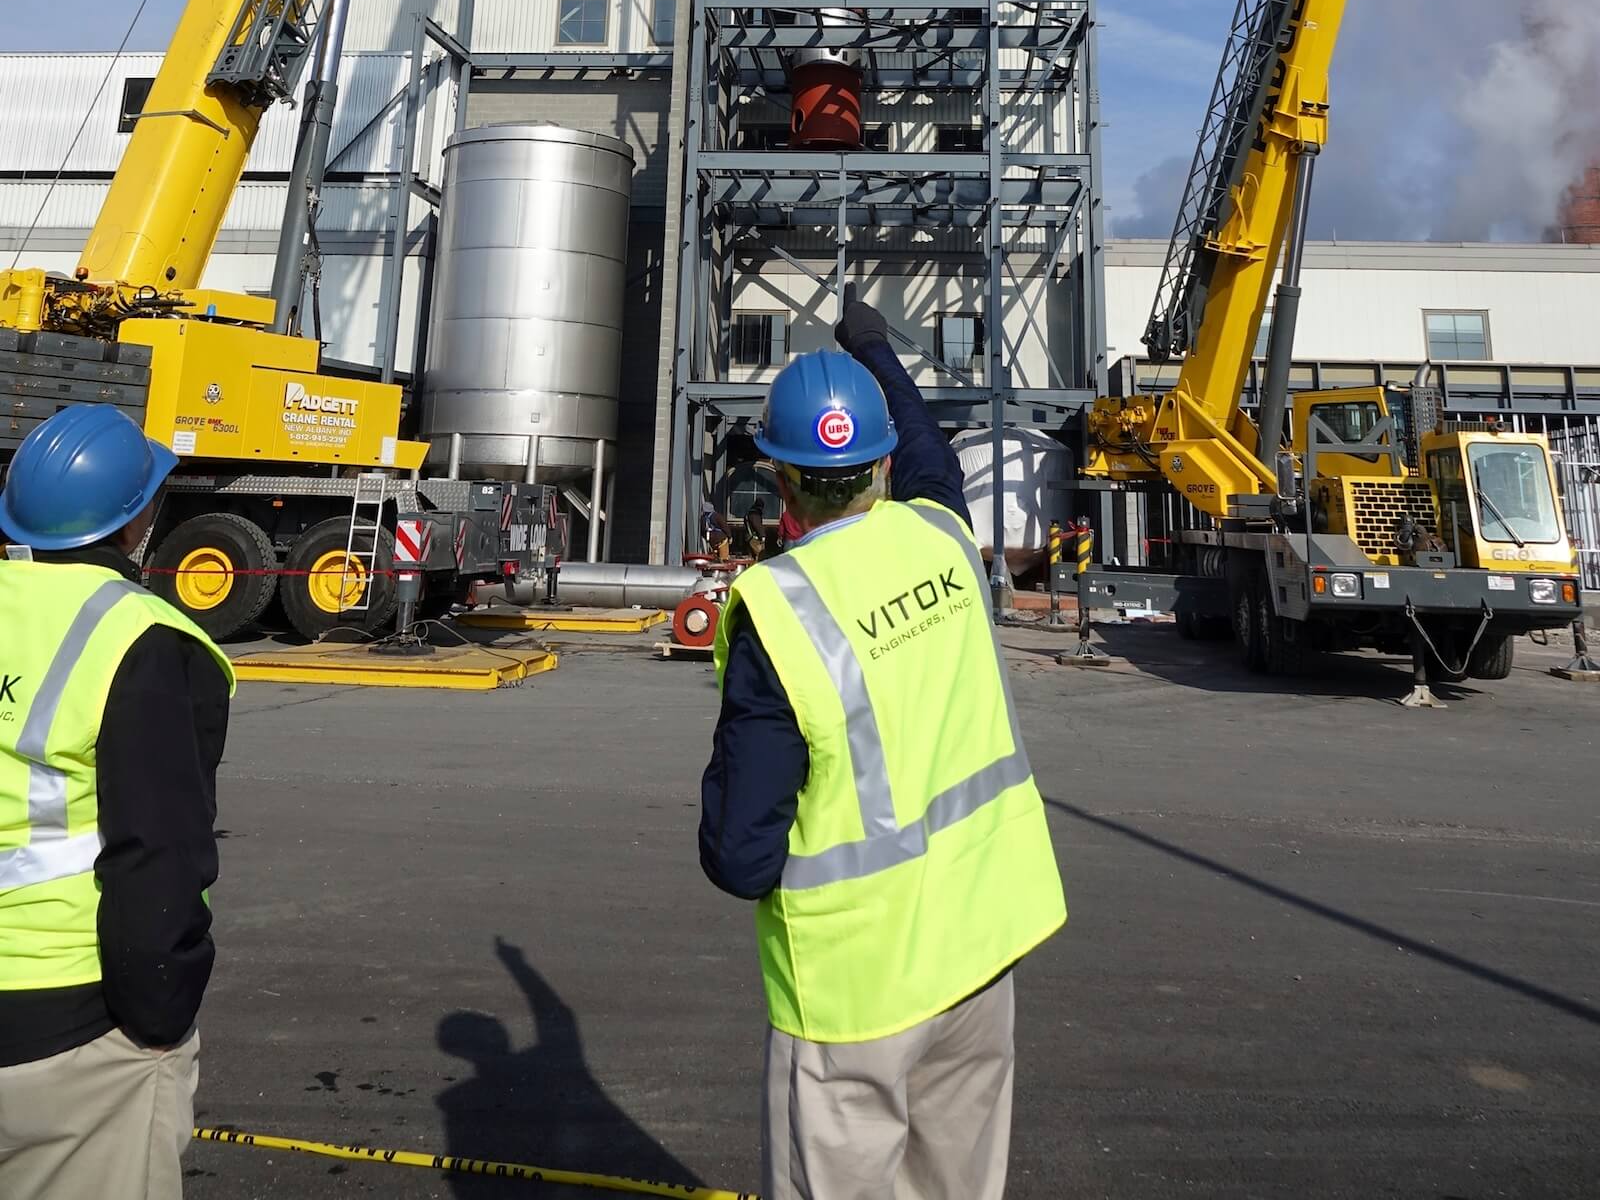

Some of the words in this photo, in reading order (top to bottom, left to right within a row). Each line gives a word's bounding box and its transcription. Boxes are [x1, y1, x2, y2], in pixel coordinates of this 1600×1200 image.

[284, 382, 358, 415] PADGETT
[175, 415, 206, 426] GROVE
[282, 412, 318, 425] CRANE
[320, 415, 357, 428] RENTAL
[213, 423, 240, 434] 6300L
[284, 424, 304, 432] NEW
[305, 426, 337, 434] ALBANY
[820, 413, 849, 445] CUBS
[482, 487, 494, 495] 82
[1187, 484, 1215, 493] GROVE
[510, 524, 528, 551] WIDE
[530, 524, 547, 550] LOAD
[856, 566, 965, 639] VITOK
[869, 613, 946, 660] ENGINEERS,
